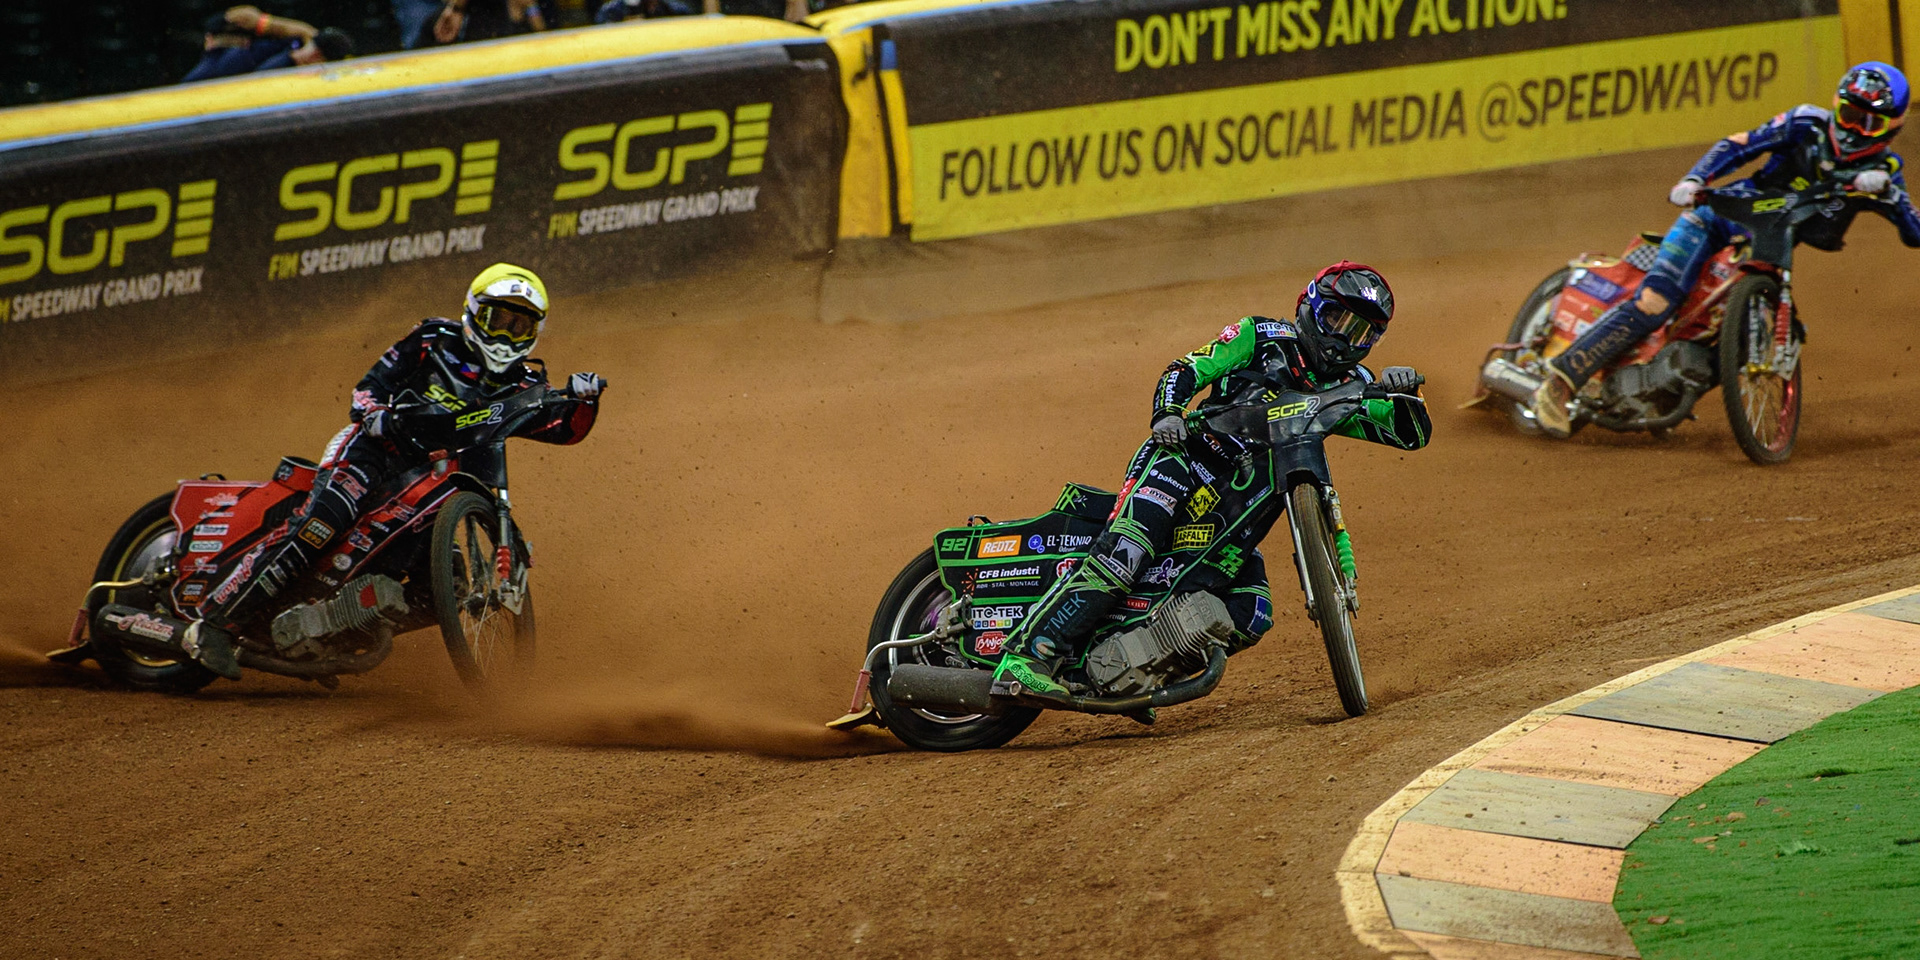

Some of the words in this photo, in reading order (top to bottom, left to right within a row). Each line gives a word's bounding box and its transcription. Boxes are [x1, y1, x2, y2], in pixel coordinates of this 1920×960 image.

[1114, 9, 1232, 73] DON'T
[1236, 1, 1321, 58] MISS
[1325, 0, 1400, 47] ANY
[939, 134, 1090, 200] FOLLOW
[1099, 128, 1143, 180] US
[1153, 120, 1206, 173] ON
[1214, 104, 1338, 166] SOCIAL
[1349, 88, 1467, 148] MEDIA
[1478, 52, 1778, 143] @SPEEDWAYGP
[547, 212, 579, 239] FIM
[577, 200, 663, 235] SPEEDWAY
[662, 189, 720, 223] GRAND
[719, 186, 761, 214] PRIX
[267, 252, 300, 281] FIM
[300, 238, 390, 276] SPEEDWAY
[388, 230, 446, 263] GRAND
[445, 225, 487, 254] PRIX
[11, 286, 100, 322] SPEEDWAY
[103, 271, 162, 308] GRAND
[162, 268, 204, 295] PRIX
[940, 538, 969, 551] 92
[978, 570, 1000, 579] CFB
[1000, 566, 1040, 577] industri
[1009, 580, 1040, 588] MONTAGE
